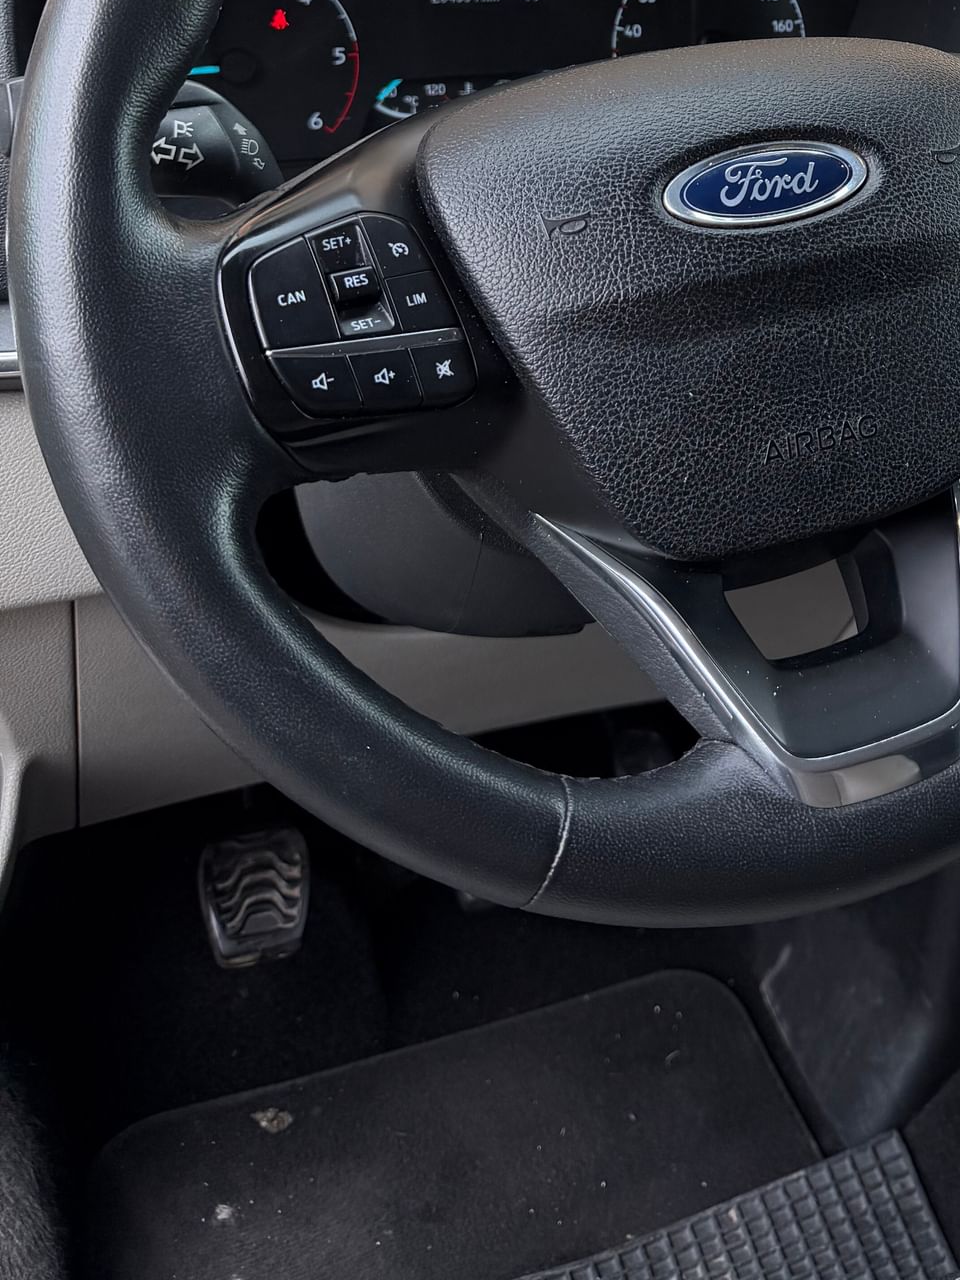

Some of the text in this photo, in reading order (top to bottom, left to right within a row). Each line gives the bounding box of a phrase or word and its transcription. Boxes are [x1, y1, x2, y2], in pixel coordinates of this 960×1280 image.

[623, 24, 642, 38] 40
[772, 19, 794, 33] 160
[332, 47, 347, 66] 5
[424, 83, 447, 96] 120
[307, 112, 324, 130] 6
[719, 156, 819, 207] Ford
[322, 235, 352, 252] SET+
[344, 273, 369, 289] RES
[277, 289, 307, 307] CAN
[405, 292, 428, 307] LIM
[350, 317, 382, 332] SET-
[763, 412, 880, 466] AIRBAG
